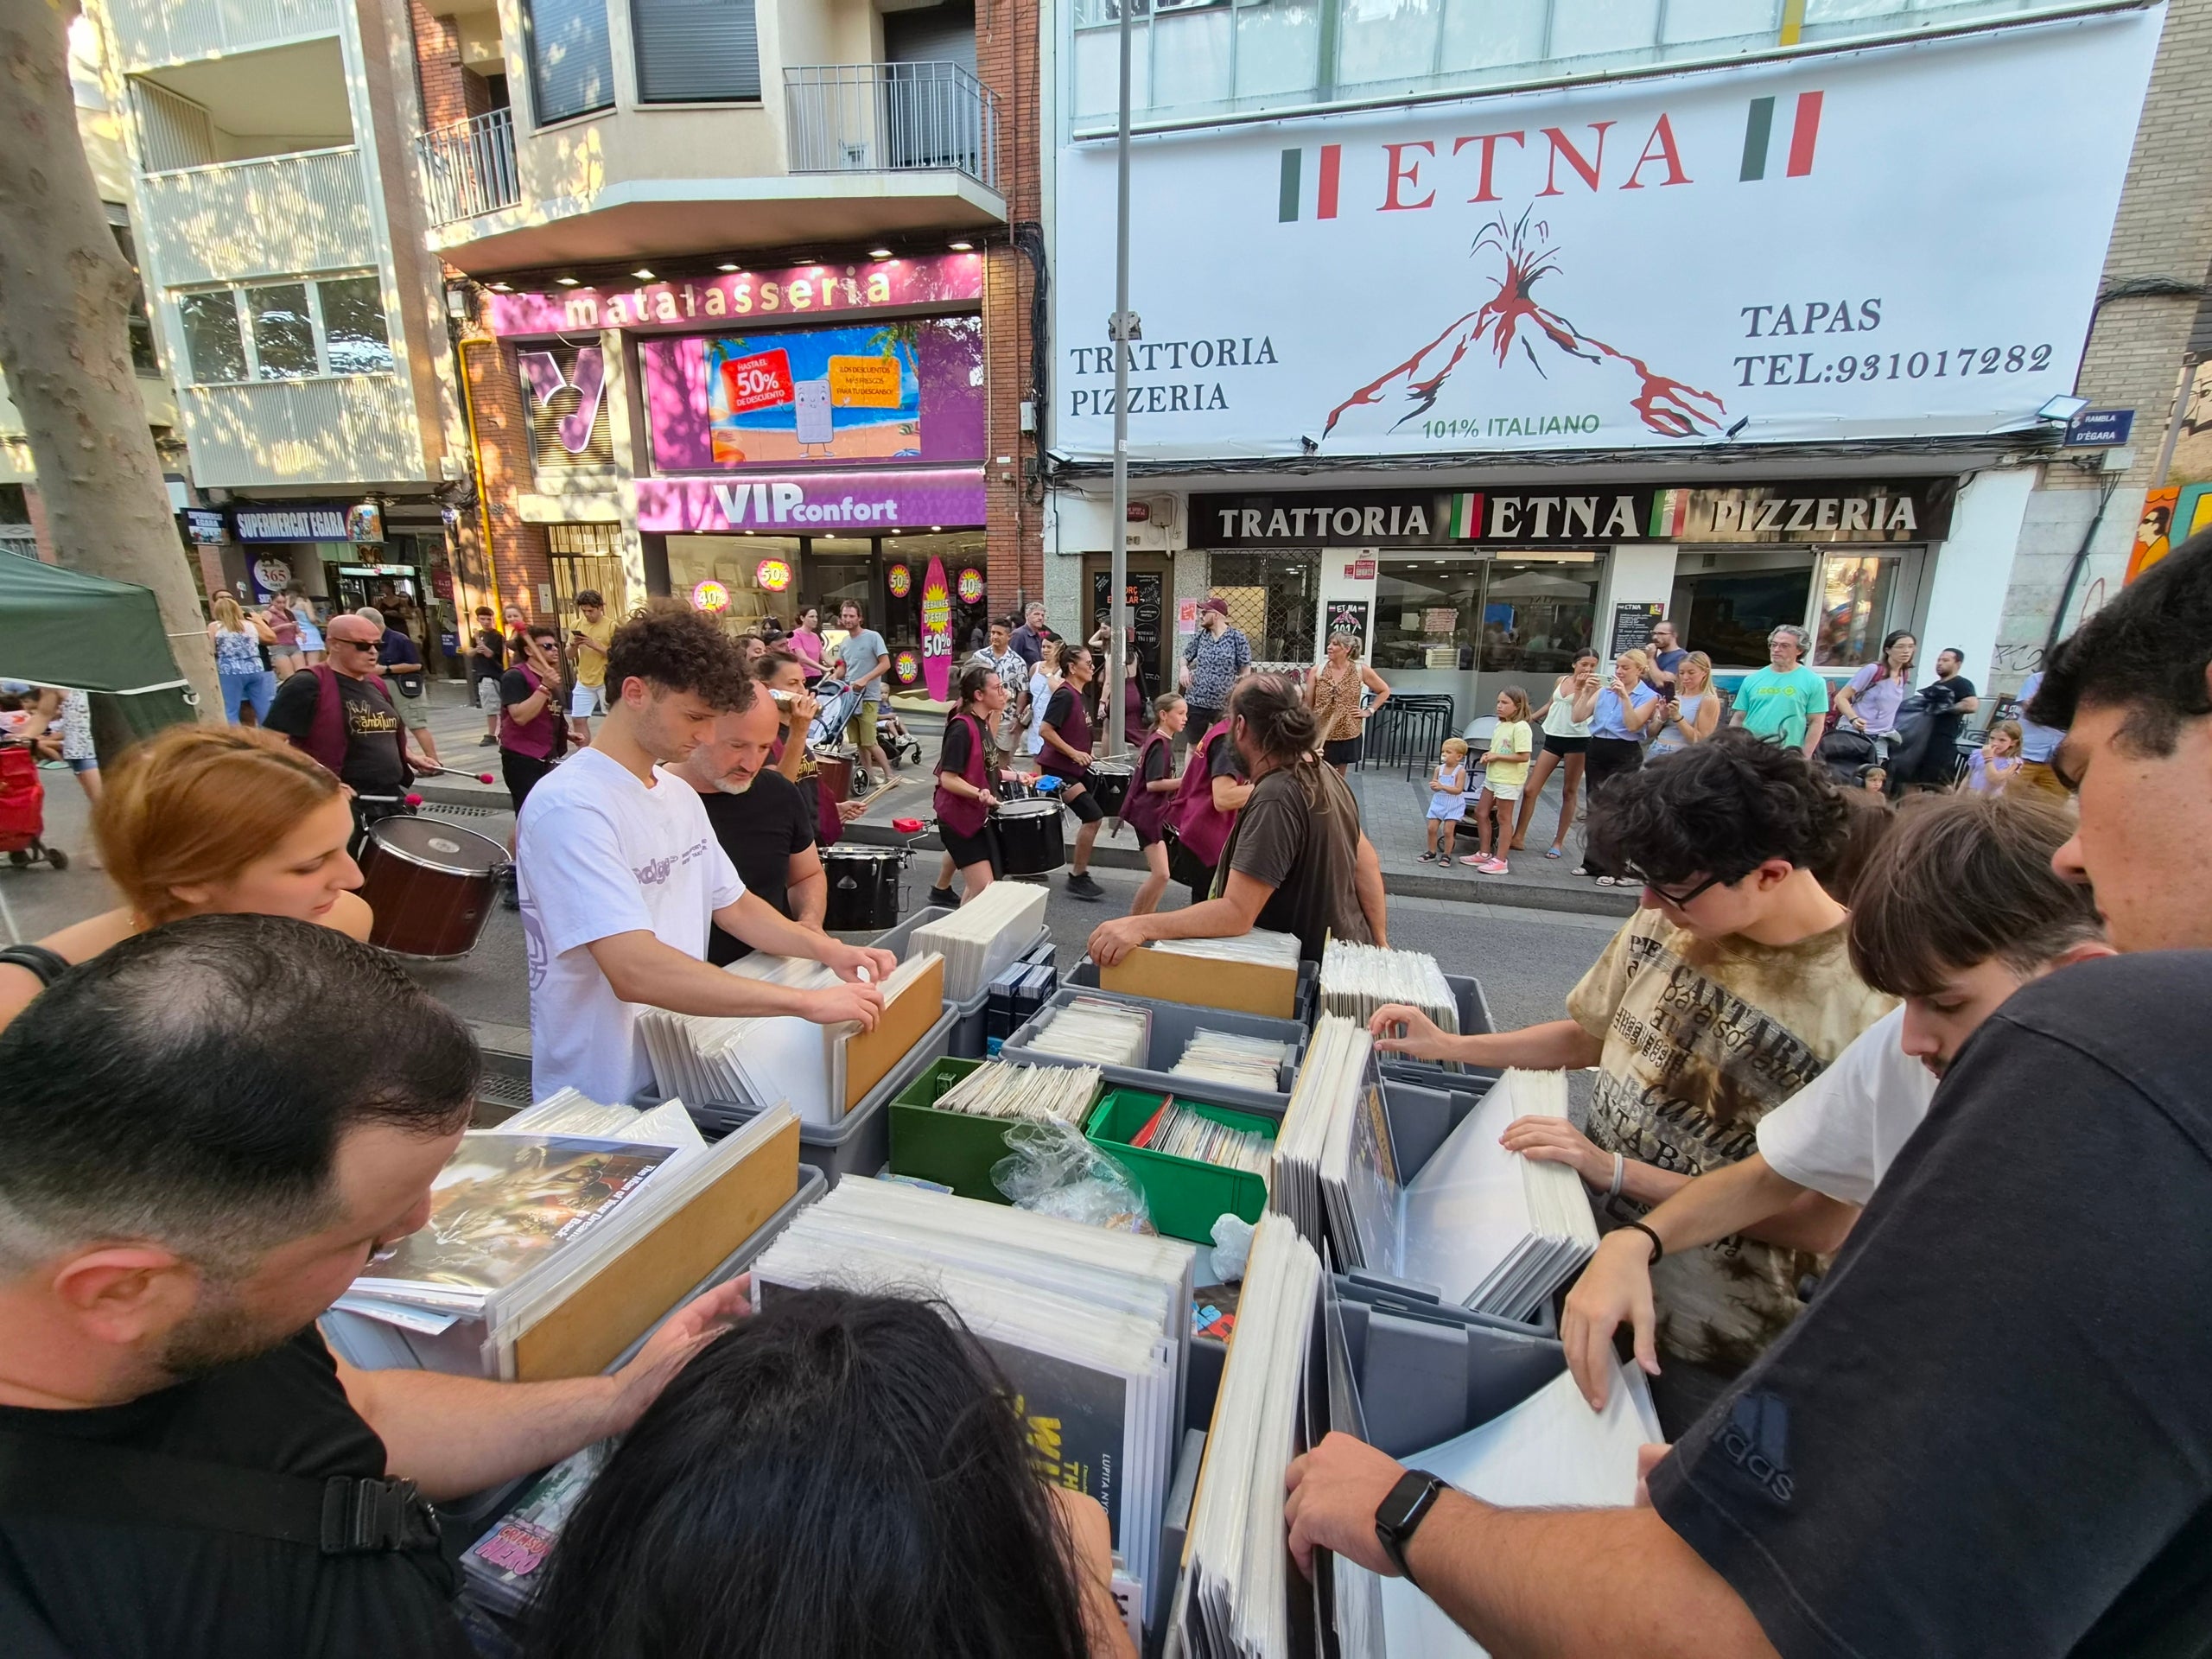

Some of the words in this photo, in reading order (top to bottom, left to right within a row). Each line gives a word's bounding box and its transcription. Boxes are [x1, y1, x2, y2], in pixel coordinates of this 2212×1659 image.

[1376, 112, 1694, 212] ETNA
[565, 265, 891, 327] matalasseria
[1740, 298, 1882, 338] TAPAS
[737, 359, 760, 372] HASTA
[759, 358, 768, 366] EL
[1070, 335, 1279, 374] TRATTORIA
[1733, 343, 2052, 387] TEL:931017282
[736, 397, 747, 406] DE
[746, 389, 785, 404] DESCUENTO
[737, 369, 779, 397] 50%
[1071, 382, 1230, 416] PIZZERIA
[1422, 418, 1479, 439] 101%
[1487, 414, 1599, 437] ITALIANO
[714, 482, 804, 524] VIP
[792, 496, 899, 523] confort
[1487, 495, 1641, 538] ETNA
[1710, 496, 1918, 532] PIZZERIA
[237, 512, 311, 537] SUPERMERCAT
[308, 512, 347, 537] EGARA
[1218, 505, 1430, 538] TRATTORIA
[262, 569, 287, 582] 365
[923, 632, 951, 658] 50%
[1102, 1453, 1111, 1489] LUPITA
[474, 1537, 543, 1575] HERO
